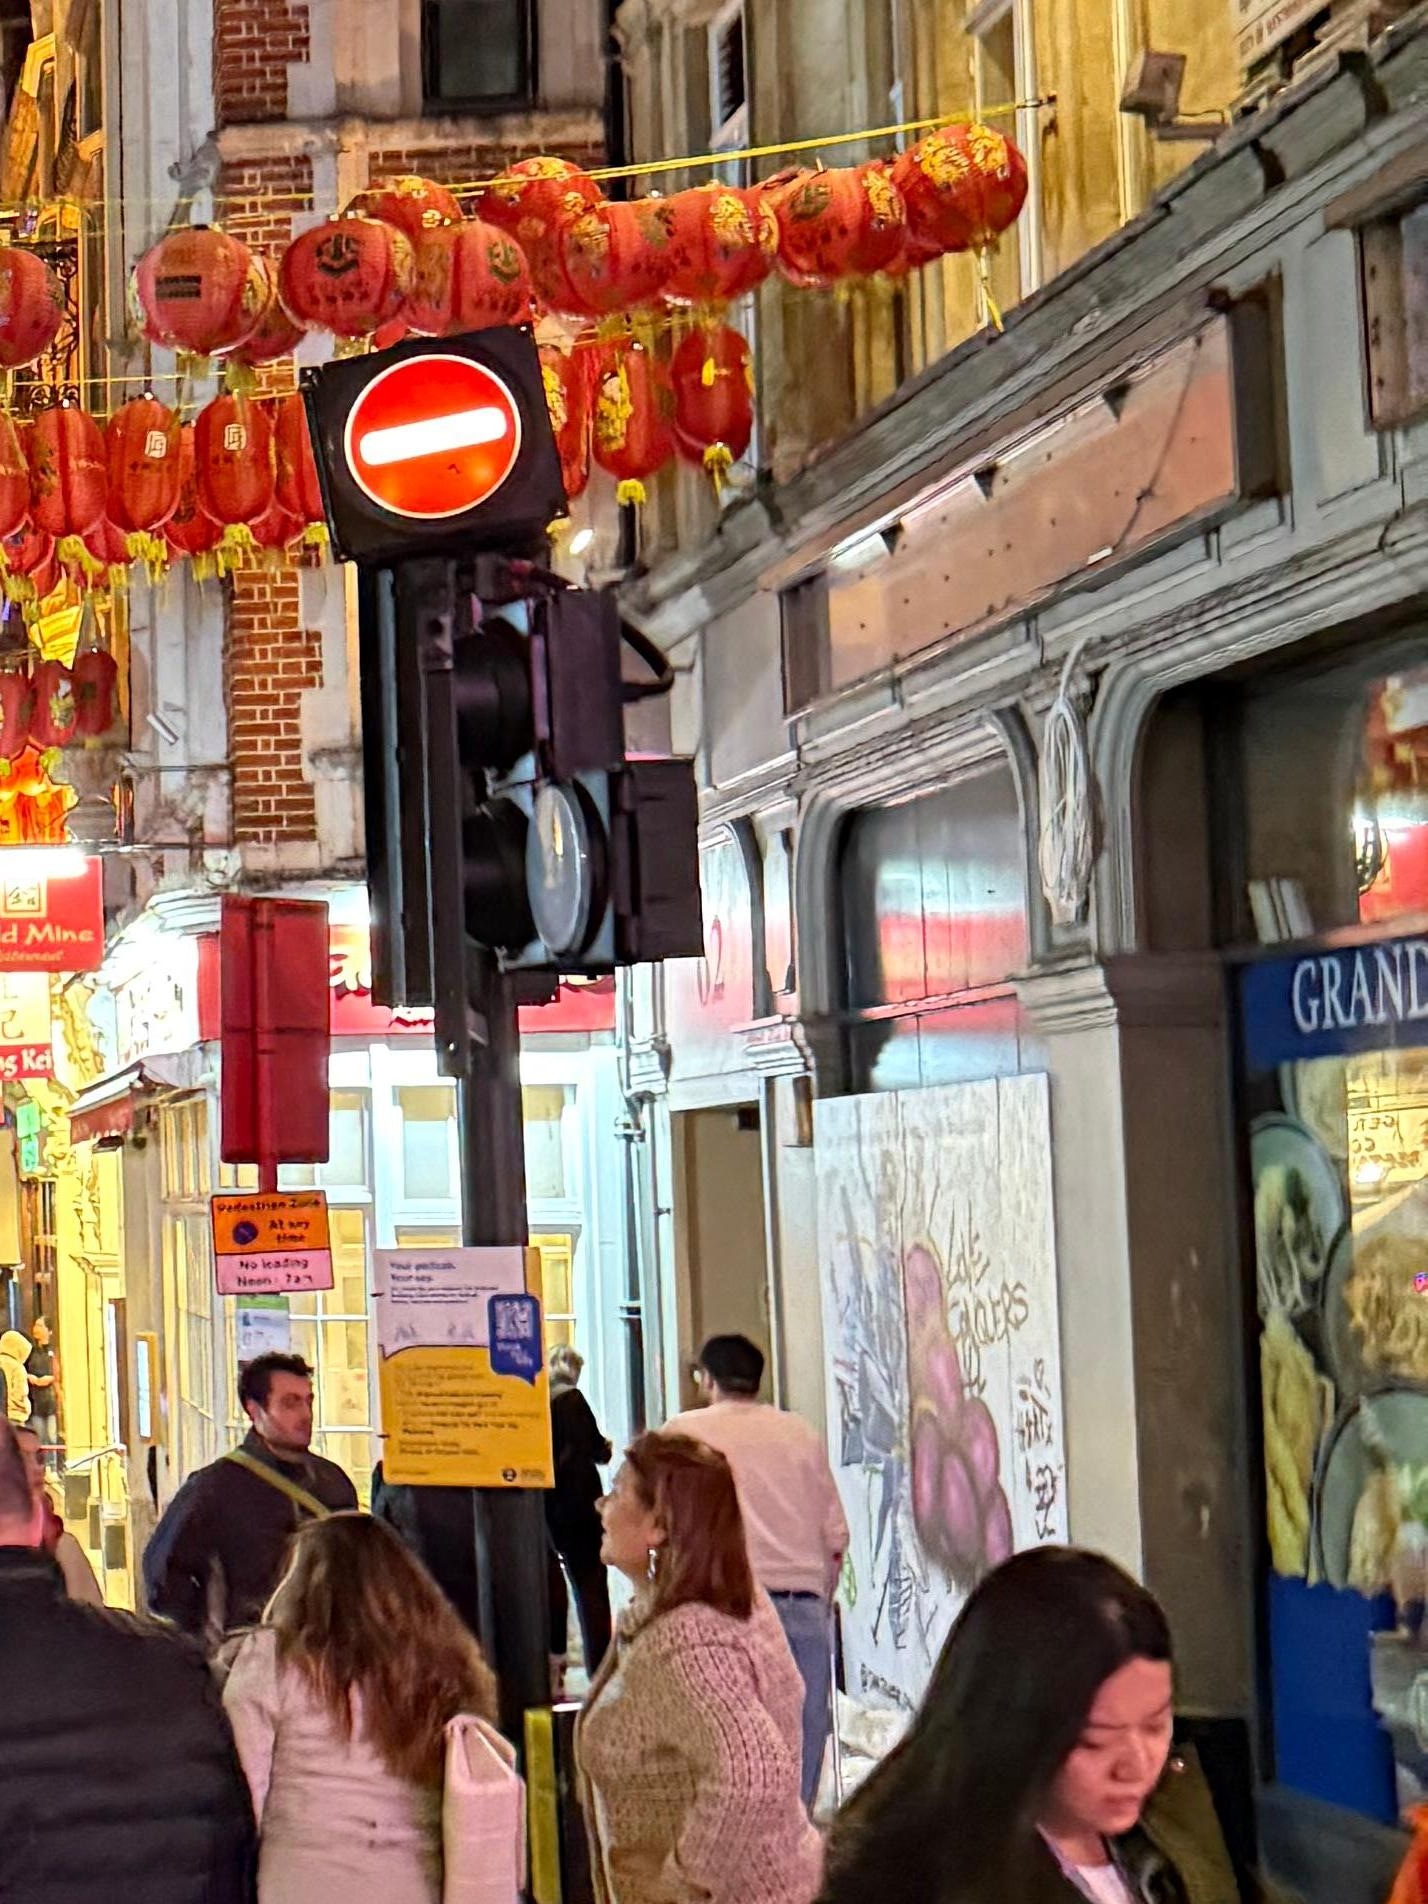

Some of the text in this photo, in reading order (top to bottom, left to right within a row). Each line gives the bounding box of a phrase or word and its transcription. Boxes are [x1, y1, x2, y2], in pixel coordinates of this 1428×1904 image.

[24, 924, 95, 945] Mine
[22, 1047, 53, 1072] Kei
[269, 1219, 284, 1230] At
[240, 1258, 309, 1270] No loading
